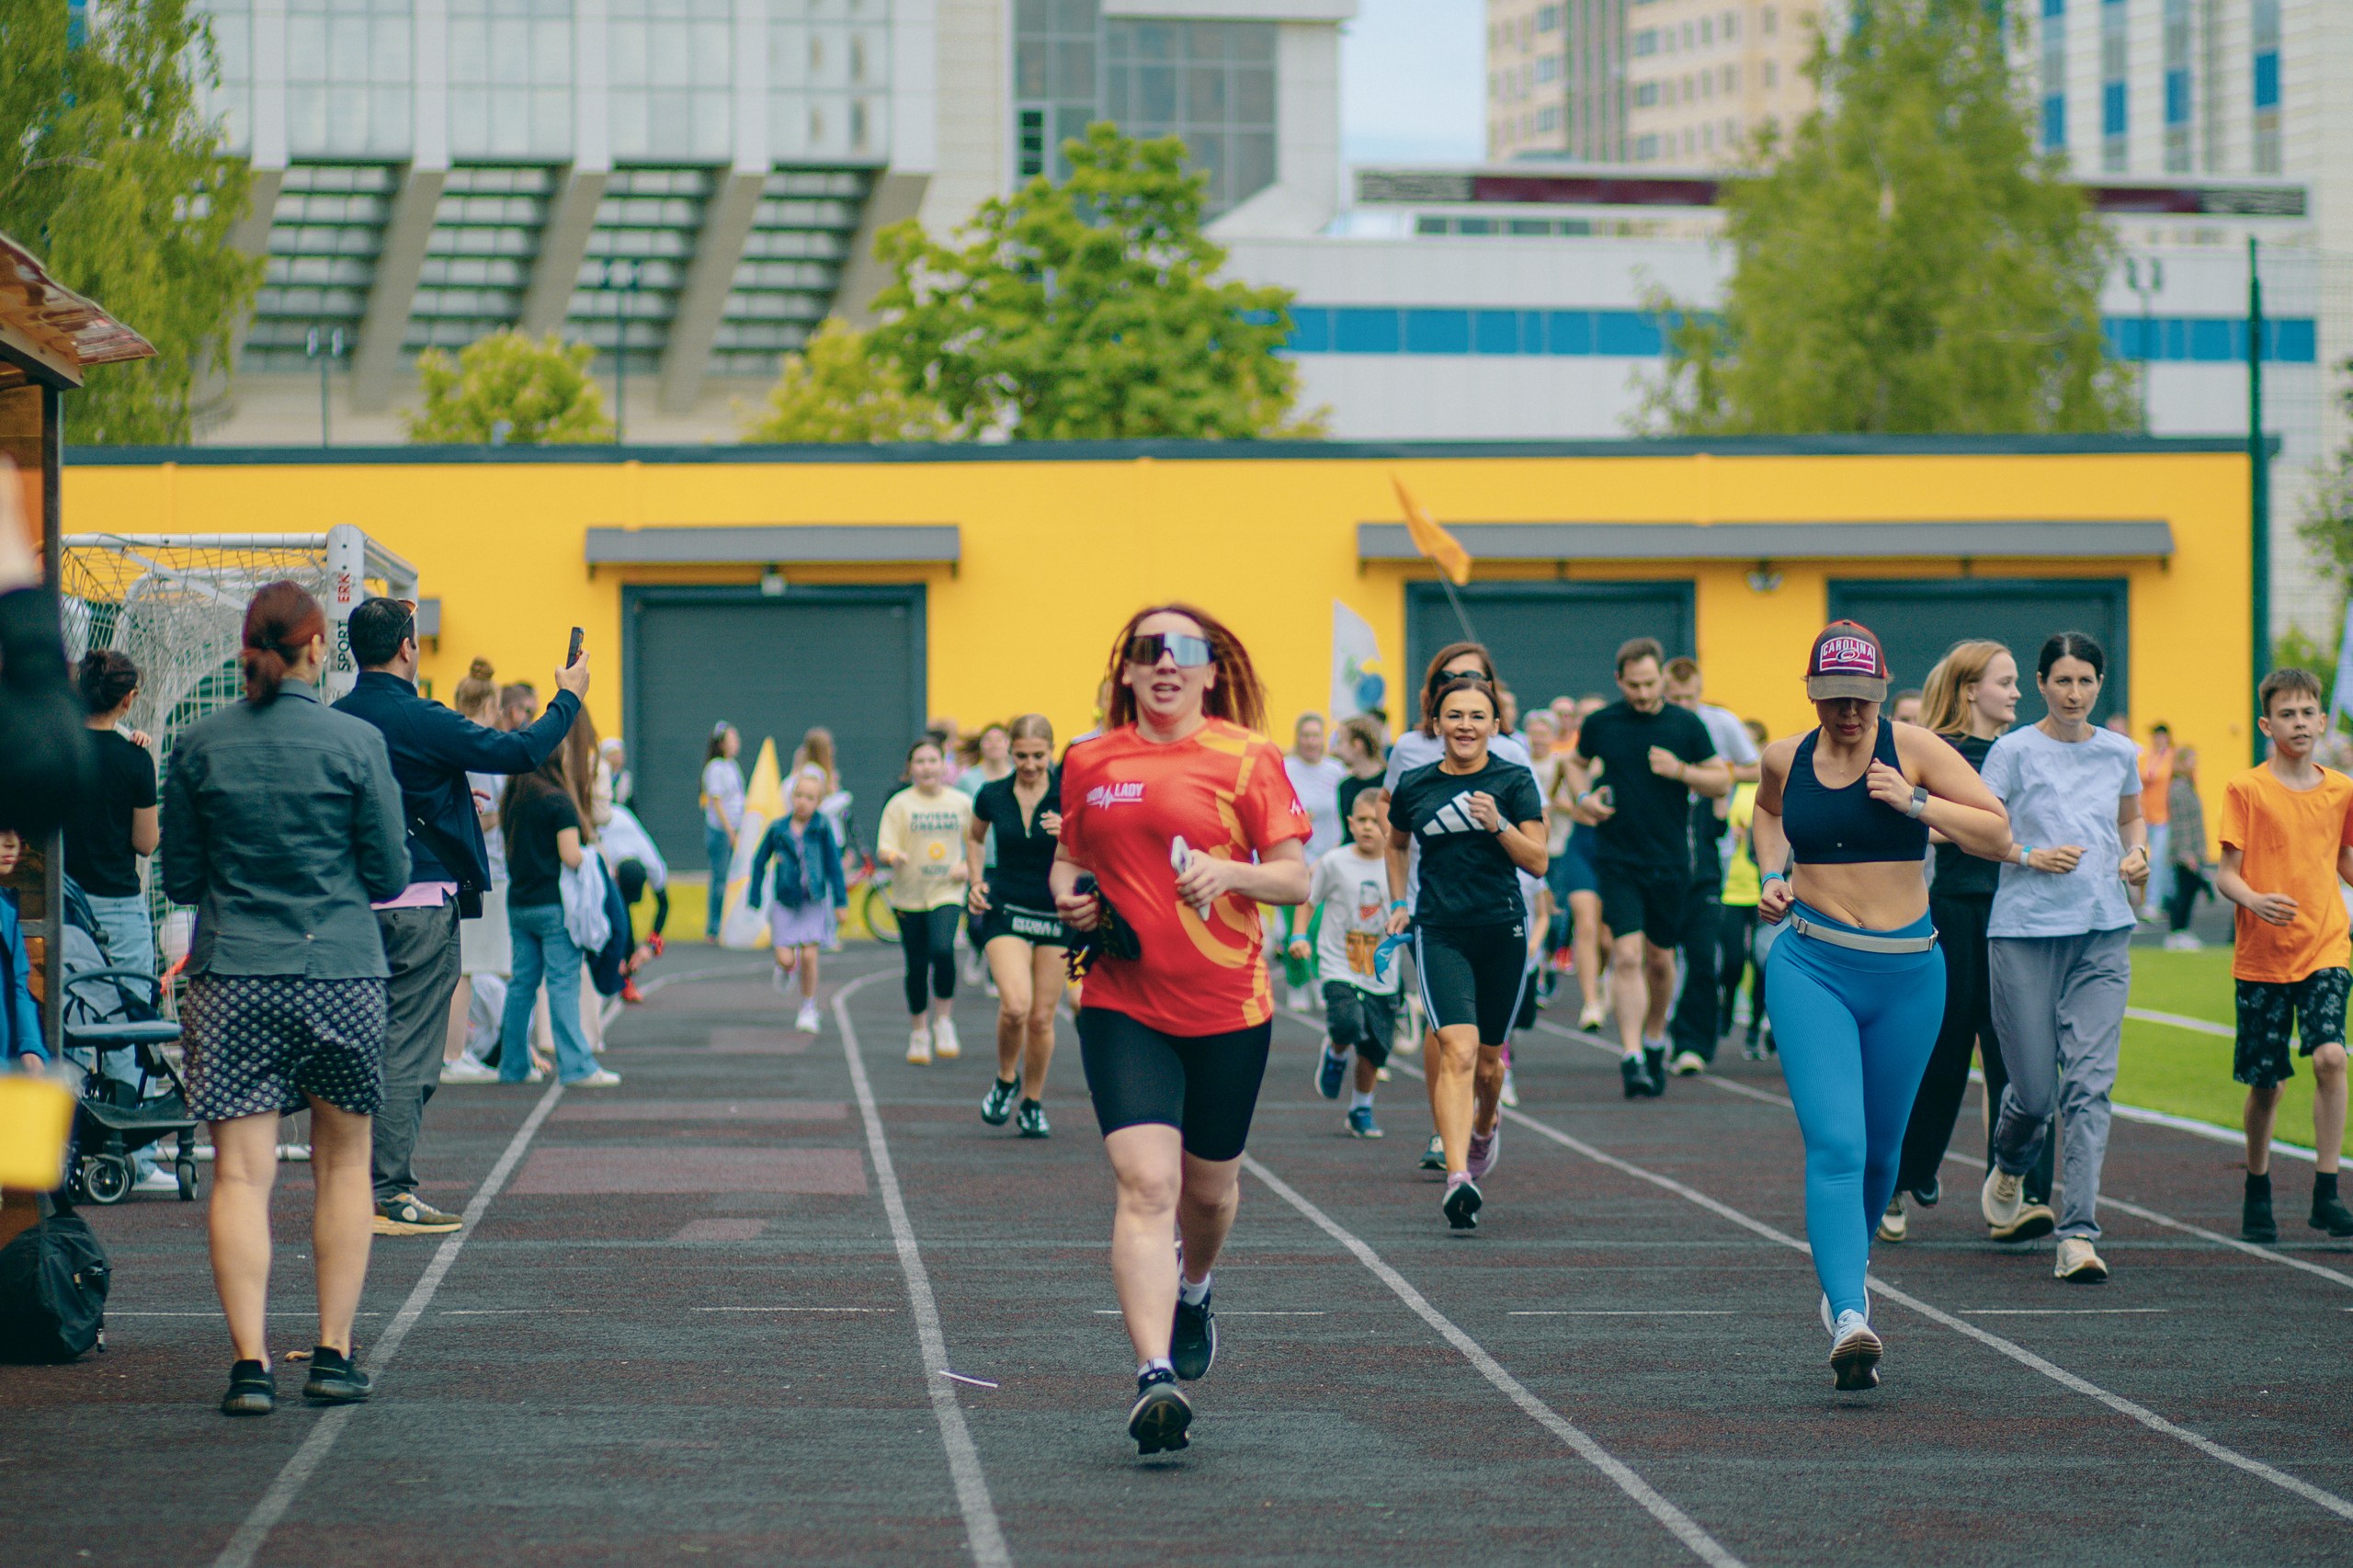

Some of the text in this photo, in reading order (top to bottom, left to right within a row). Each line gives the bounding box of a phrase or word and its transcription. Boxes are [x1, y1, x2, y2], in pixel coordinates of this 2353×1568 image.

[337, 620, 350, 671] SPORT
[1822, 639, 1873, 659] CAROLINA
[1115, 783, 1143, 797] LADY
